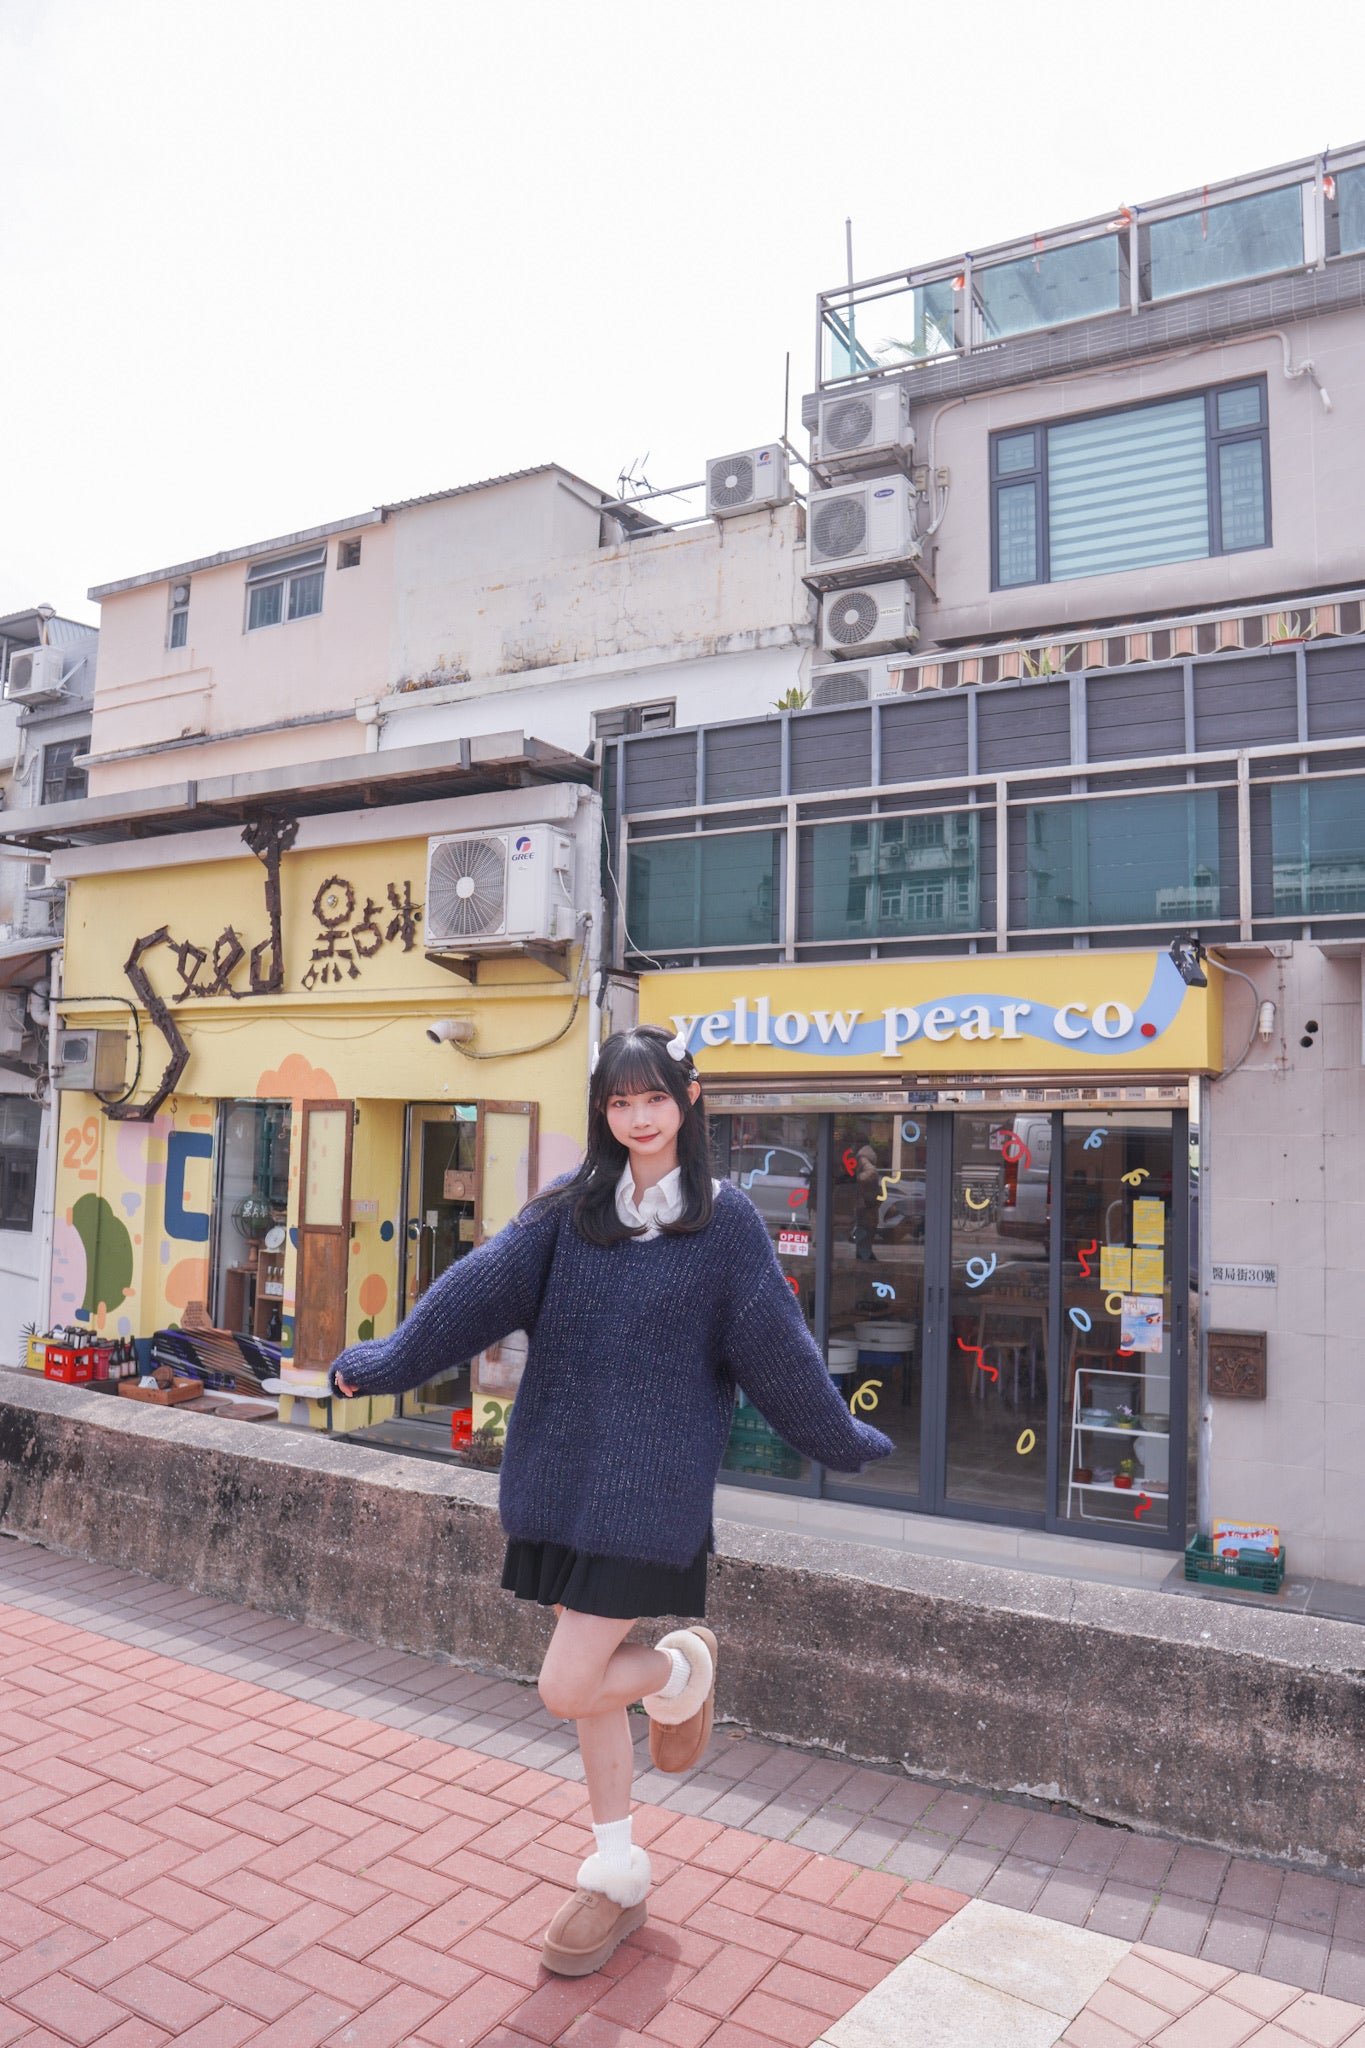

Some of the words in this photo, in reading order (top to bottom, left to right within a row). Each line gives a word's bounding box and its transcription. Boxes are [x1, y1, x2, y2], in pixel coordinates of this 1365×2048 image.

[876, 690, 899, 698] HITACHI
[511, 852, 536, 862] GREE
[669, 995, 863, 1048] yellow
[880, 1001, 1031, 1058] pear
[1053, 1000, 1158, 1040] co.
[63, 1115, 100, 1169] 29
[779, 1232, 809, 1243] OPEN
[1212, 1266, 1276, 1283] 醫局街30號
[482, 1400, 515, 1437] 2
